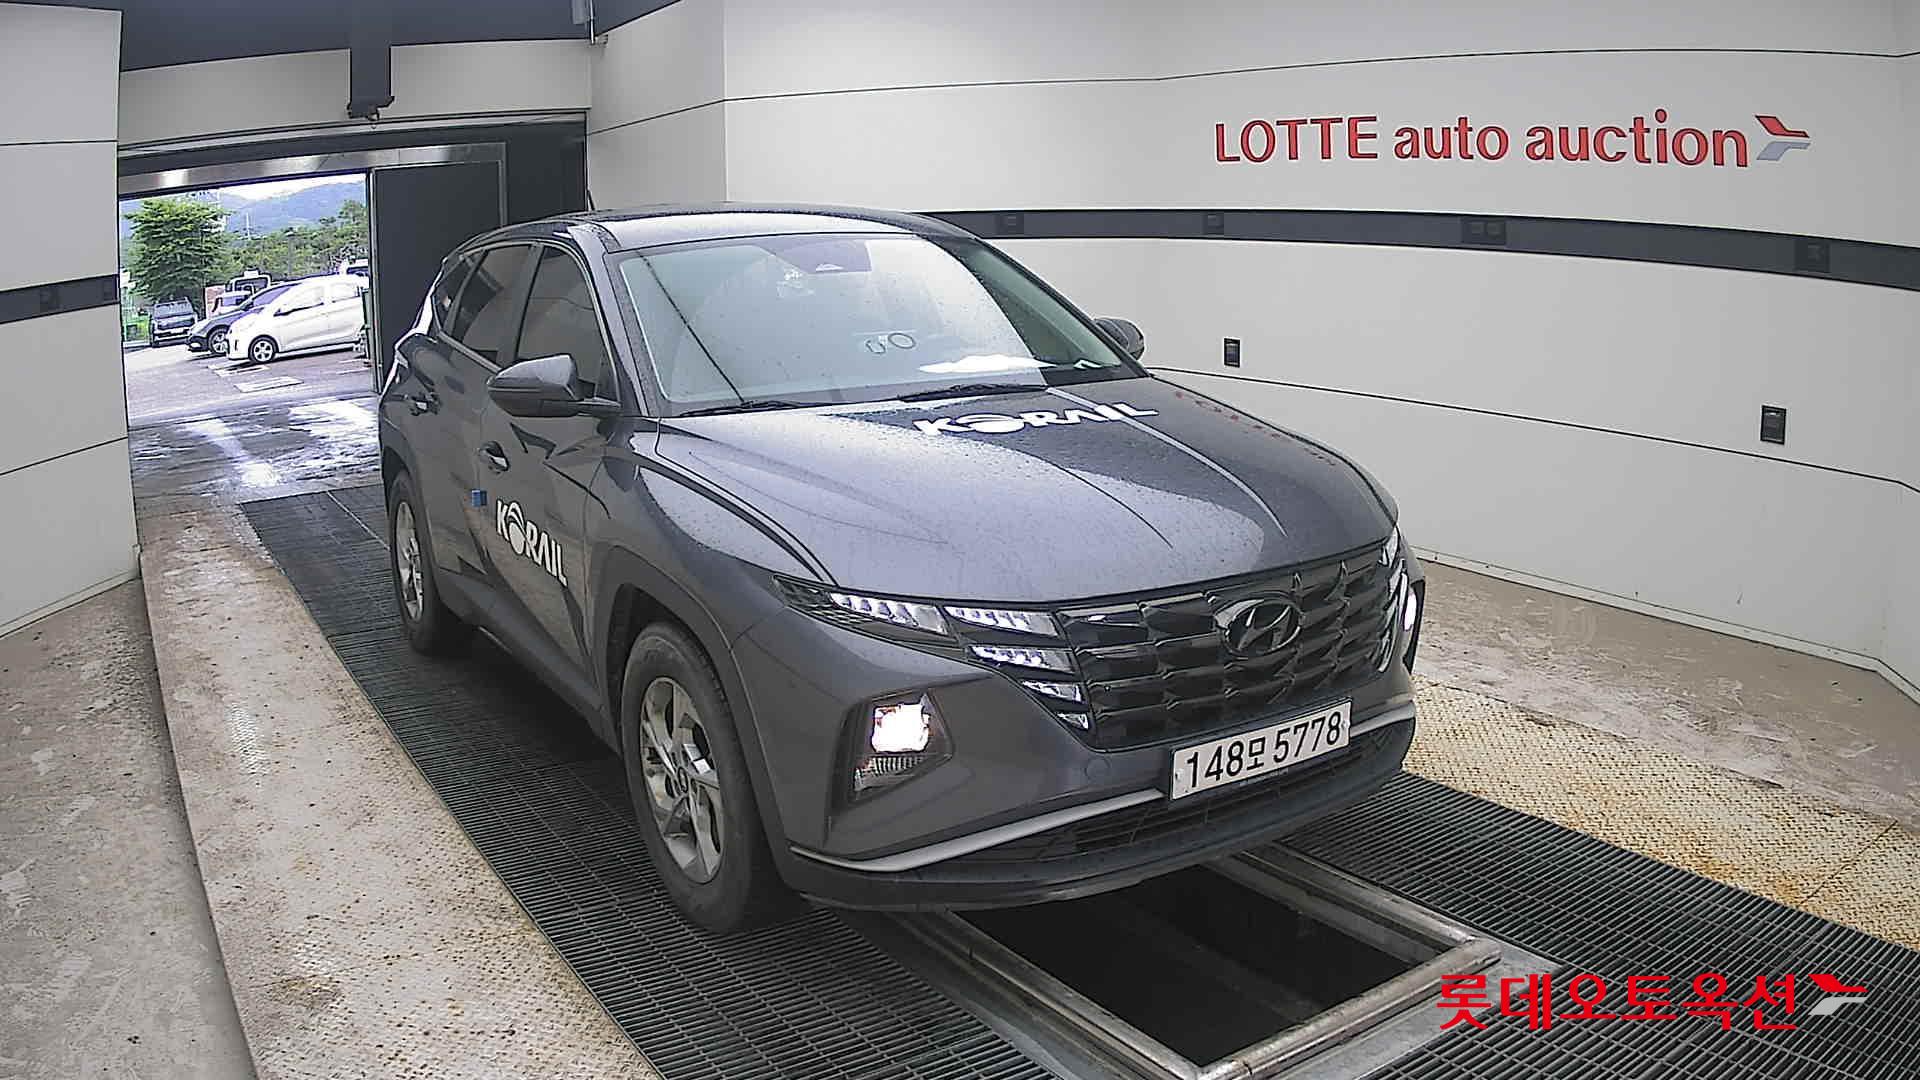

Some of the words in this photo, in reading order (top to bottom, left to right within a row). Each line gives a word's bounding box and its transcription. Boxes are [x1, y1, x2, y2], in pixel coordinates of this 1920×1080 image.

[1215, 116, 1378, 163] LOTTE
[1393, 116, 1510, 161] auto
[1525, 109, 1749, 168] auction
[912, 401, 1159, 435] KORAIL
[496, 499, 568, 588] KORAIL
[1272, 711, 1342, 764] 5778
